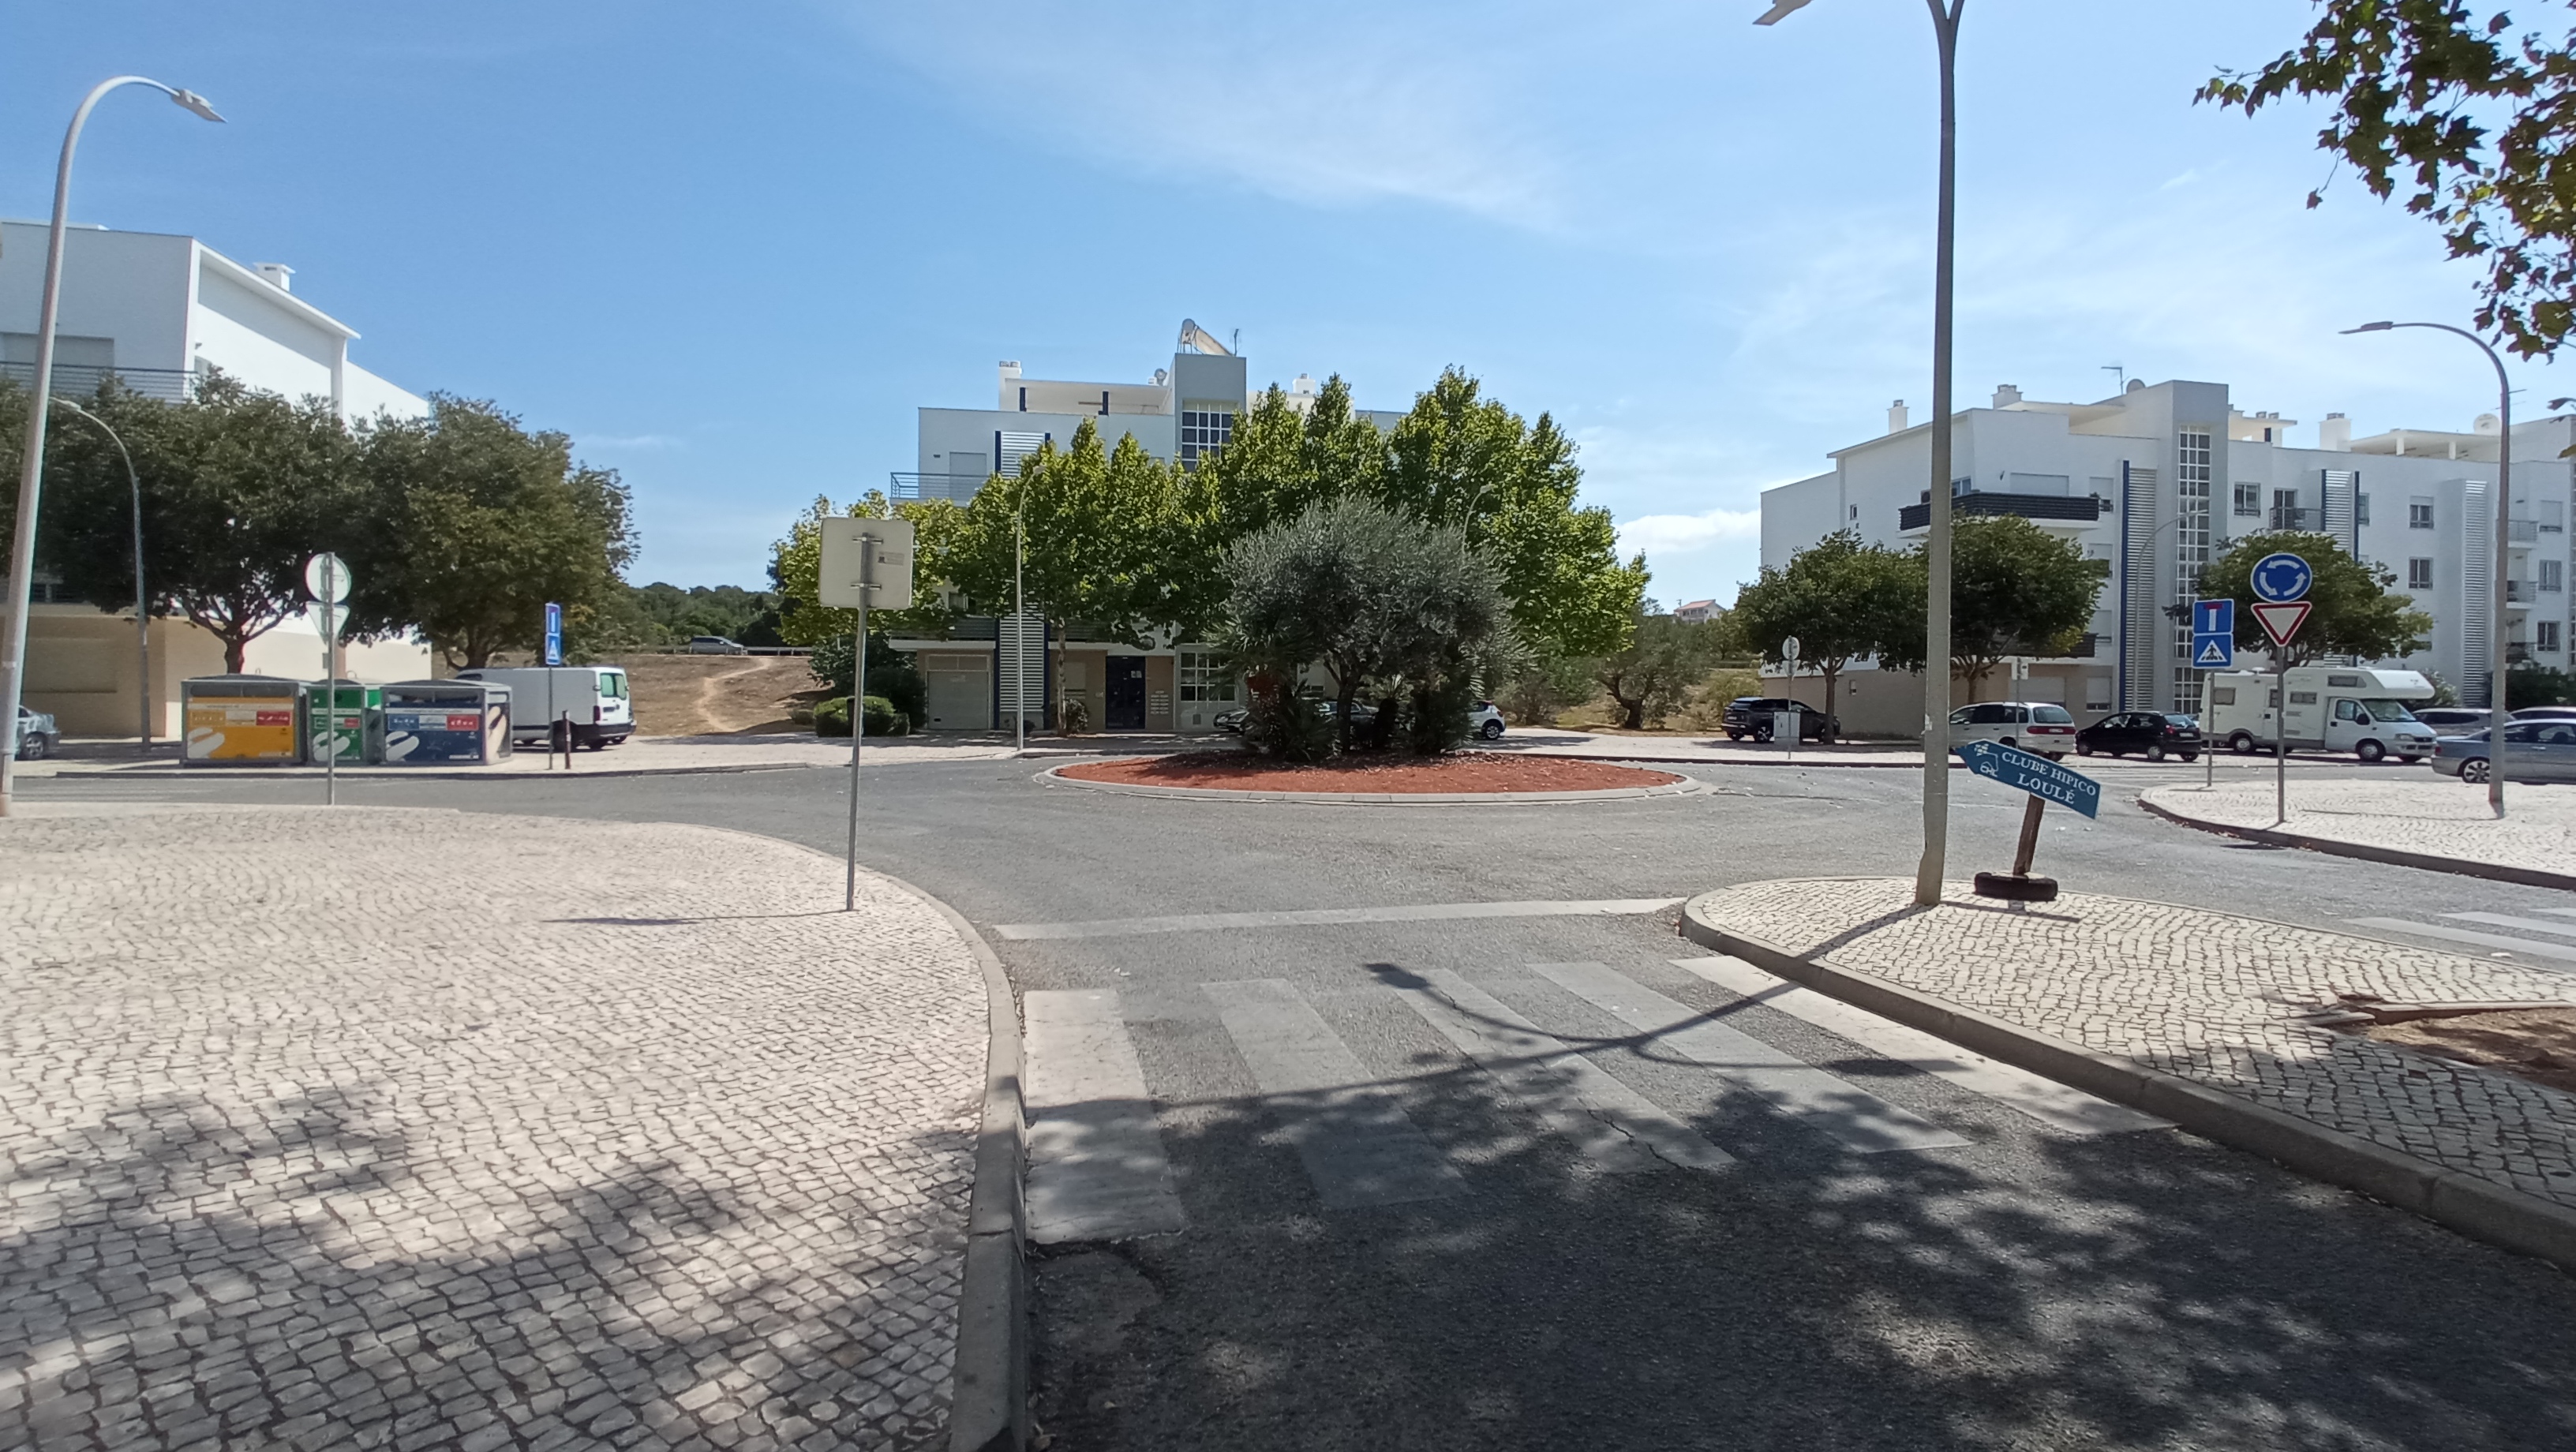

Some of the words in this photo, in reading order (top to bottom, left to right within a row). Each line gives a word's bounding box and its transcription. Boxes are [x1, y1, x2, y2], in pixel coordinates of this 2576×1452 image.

[2001, 751, 2049, 775] CLUBE
[2050, 767, 2096, 796] HIPICO
[2017, 773, 2075, 804] LOULÉ
